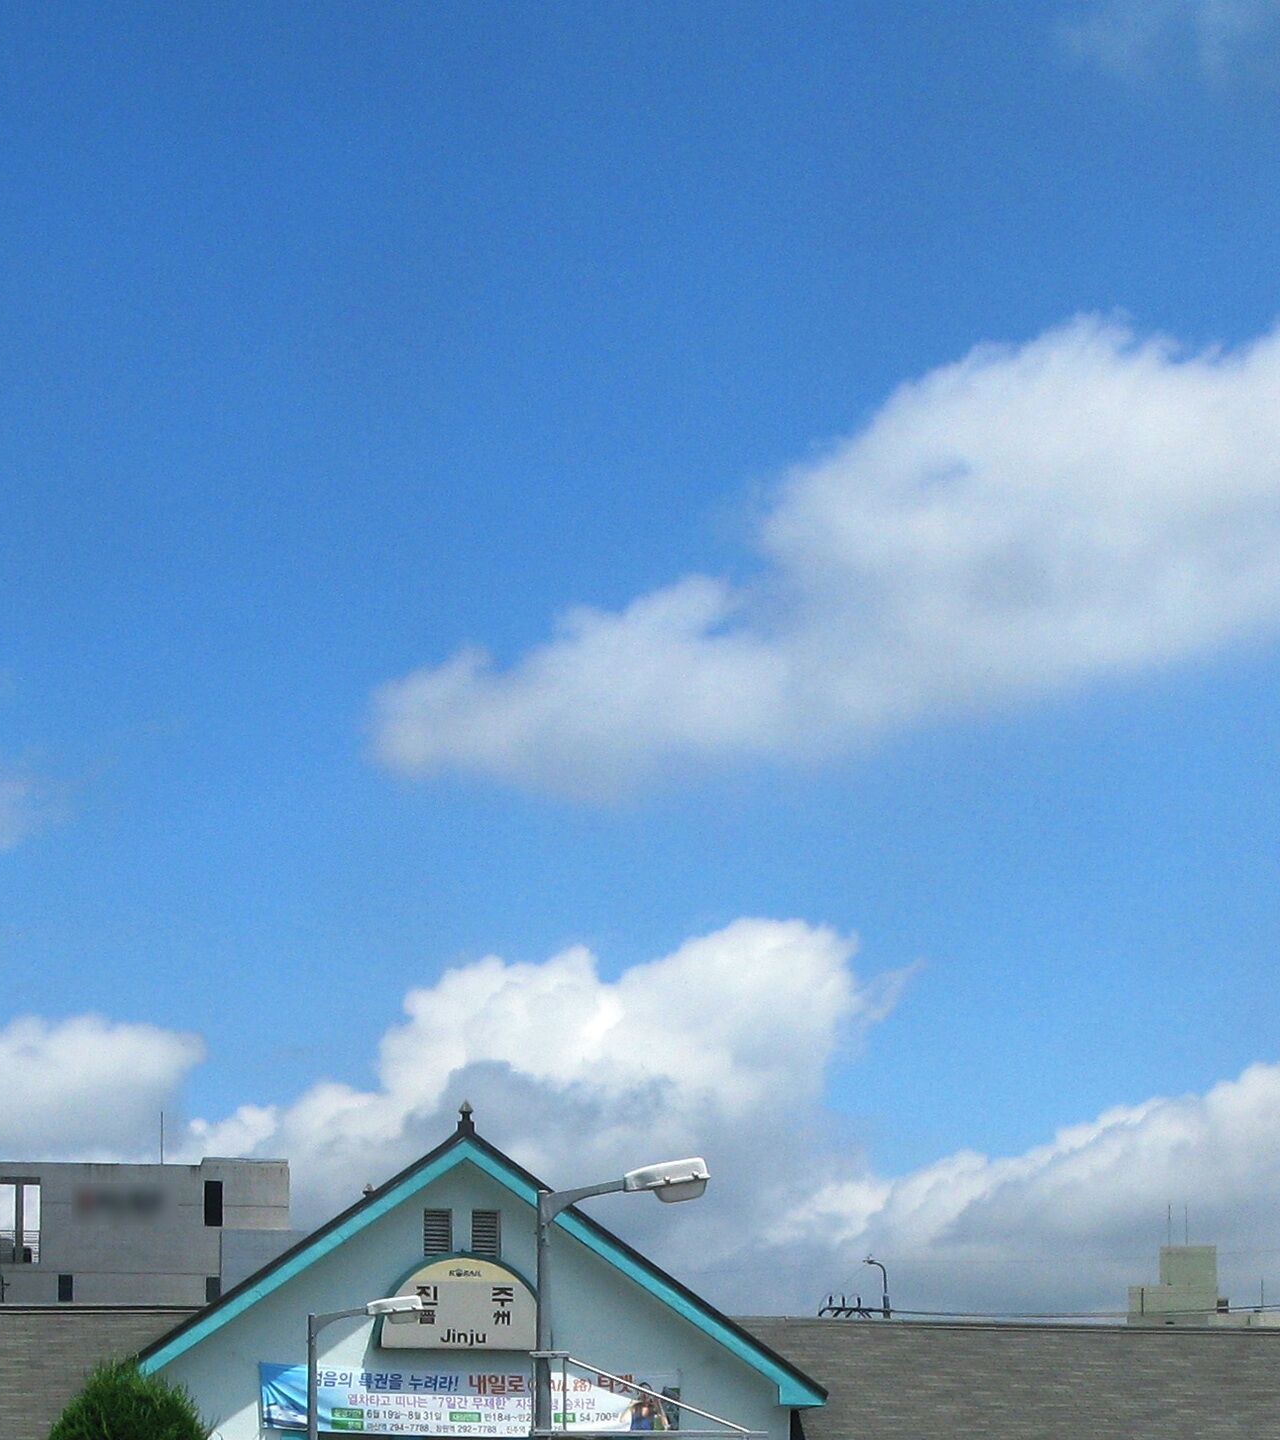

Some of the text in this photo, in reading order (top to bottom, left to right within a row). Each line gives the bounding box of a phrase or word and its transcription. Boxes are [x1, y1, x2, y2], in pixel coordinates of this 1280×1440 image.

[449, 1268, 481, 1278] KORAIL
[440, 1328, 487, 1347] Jinju
[409, 1375, 458, 1391] 누려라!
[348, 1394, 391, 1407] 열차타고
